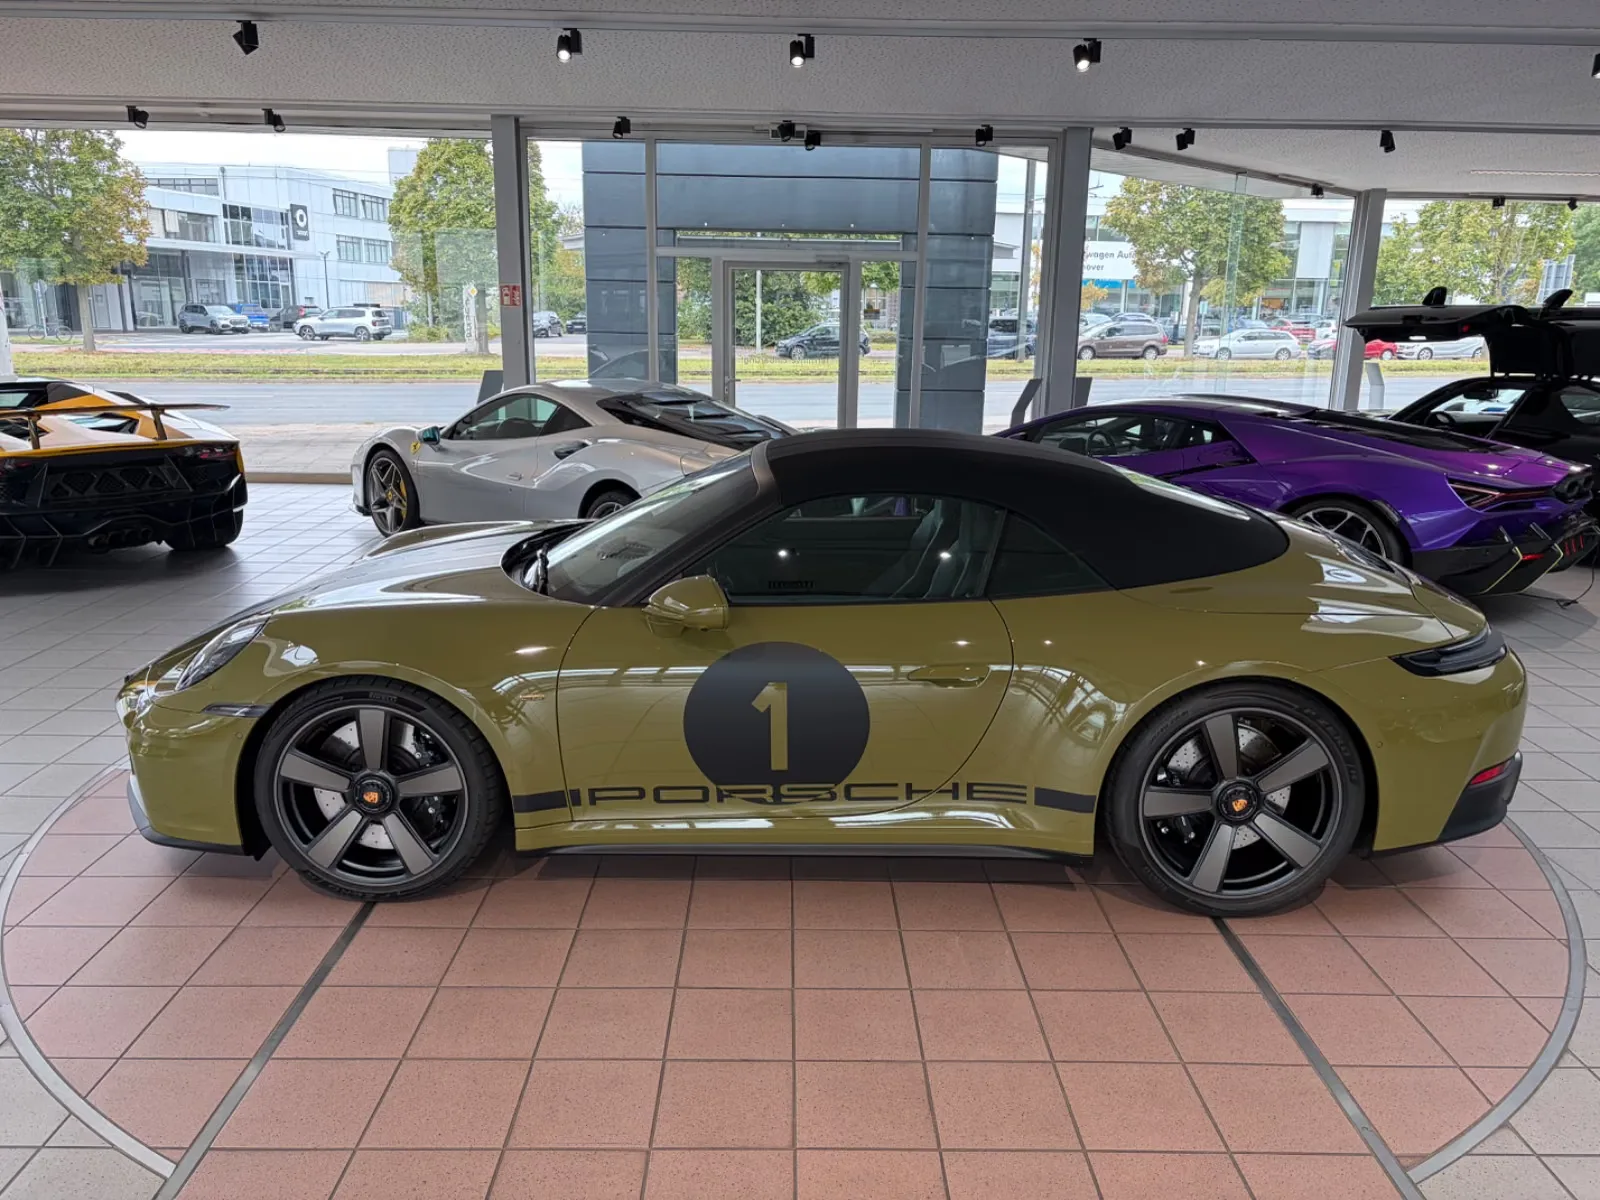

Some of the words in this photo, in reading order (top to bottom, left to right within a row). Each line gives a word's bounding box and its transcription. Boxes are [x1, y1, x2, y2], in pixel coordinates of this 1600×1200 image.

[1086, 251, 1115, 260] wagen
[751, 681, 788, 771] 1
[587, 782, 1027, 806] PORSCHE
